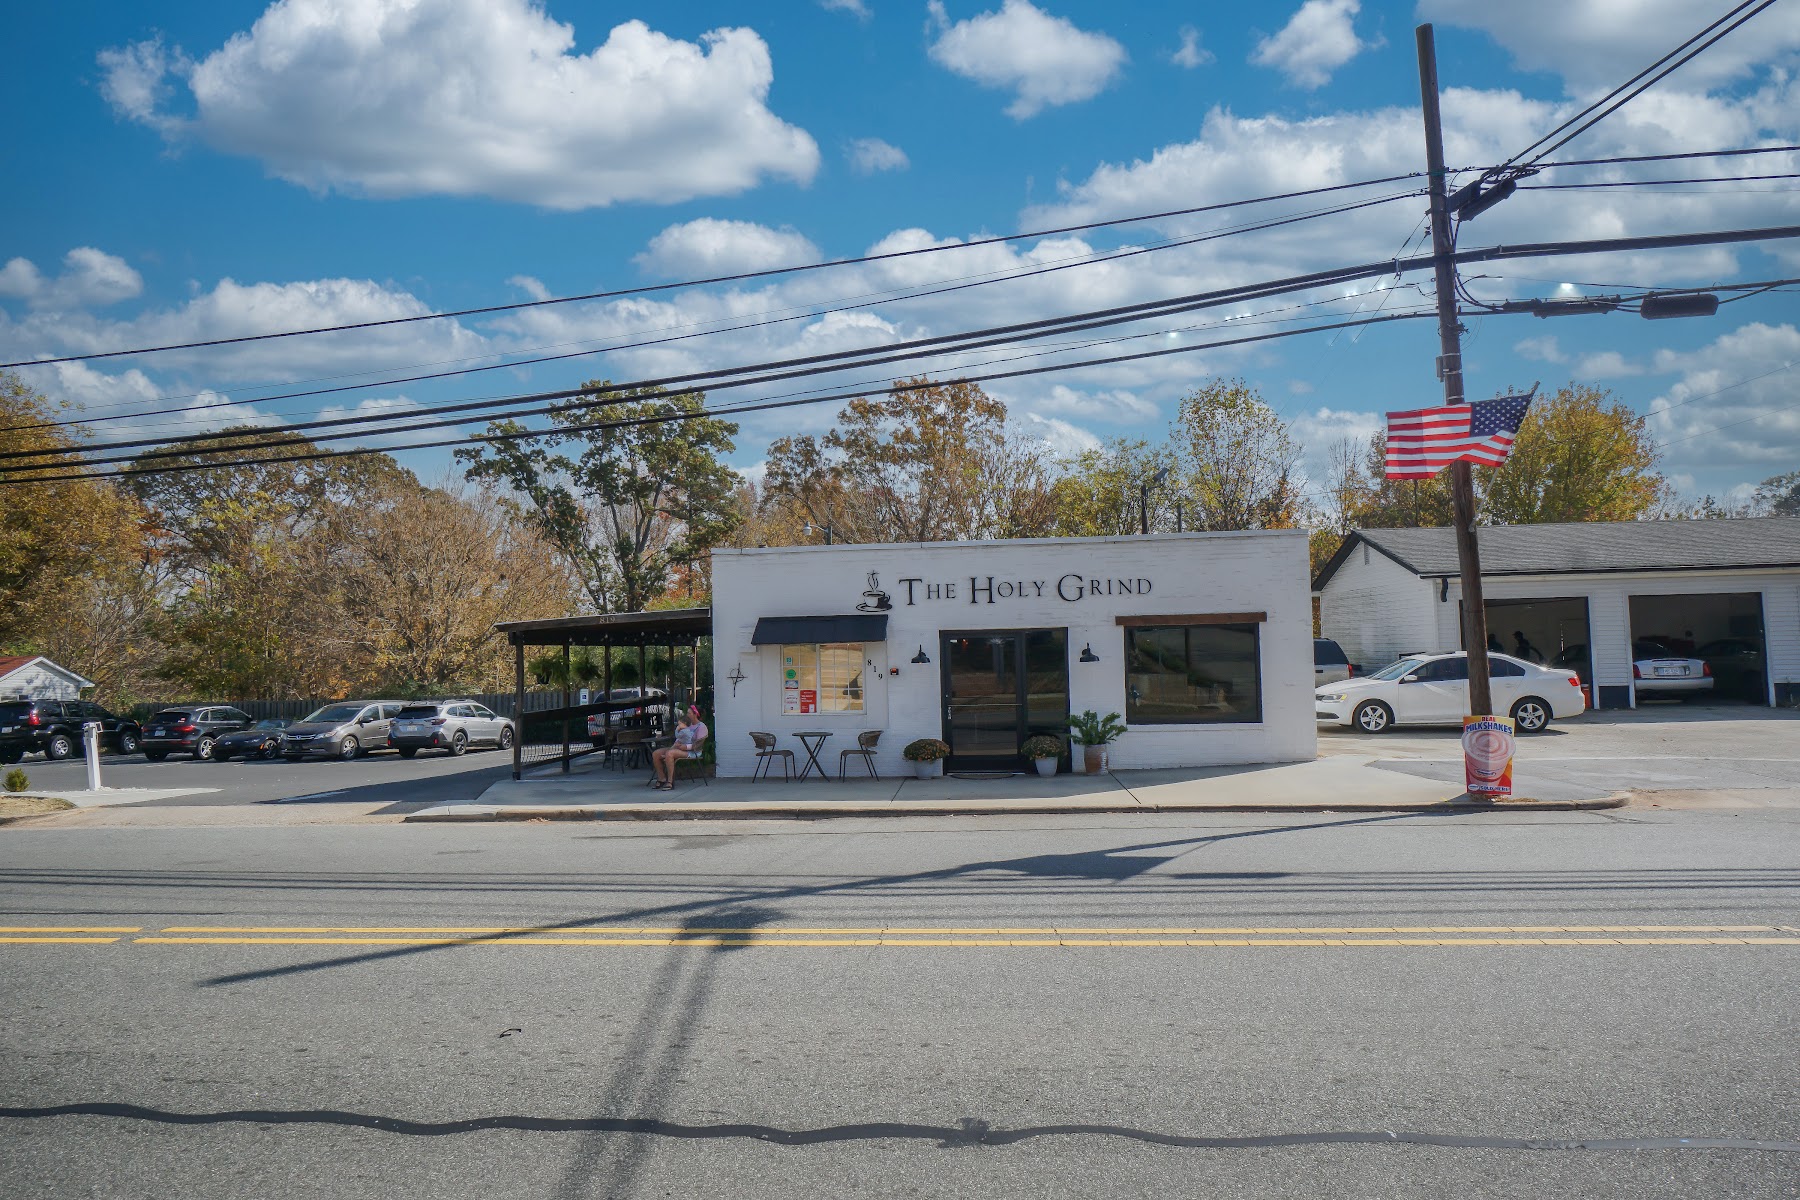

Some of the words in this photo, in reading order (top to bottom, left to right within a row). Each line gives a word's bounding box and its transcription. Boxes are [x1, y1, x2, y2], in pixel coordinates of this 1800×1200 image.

[898, 578, 956, 606] THE
[970, 576, 1045, 604] HOLY
[1057, 574, 1153, 602] GRIND
[1465, 721, 1513, 735] MILKSHAKES
